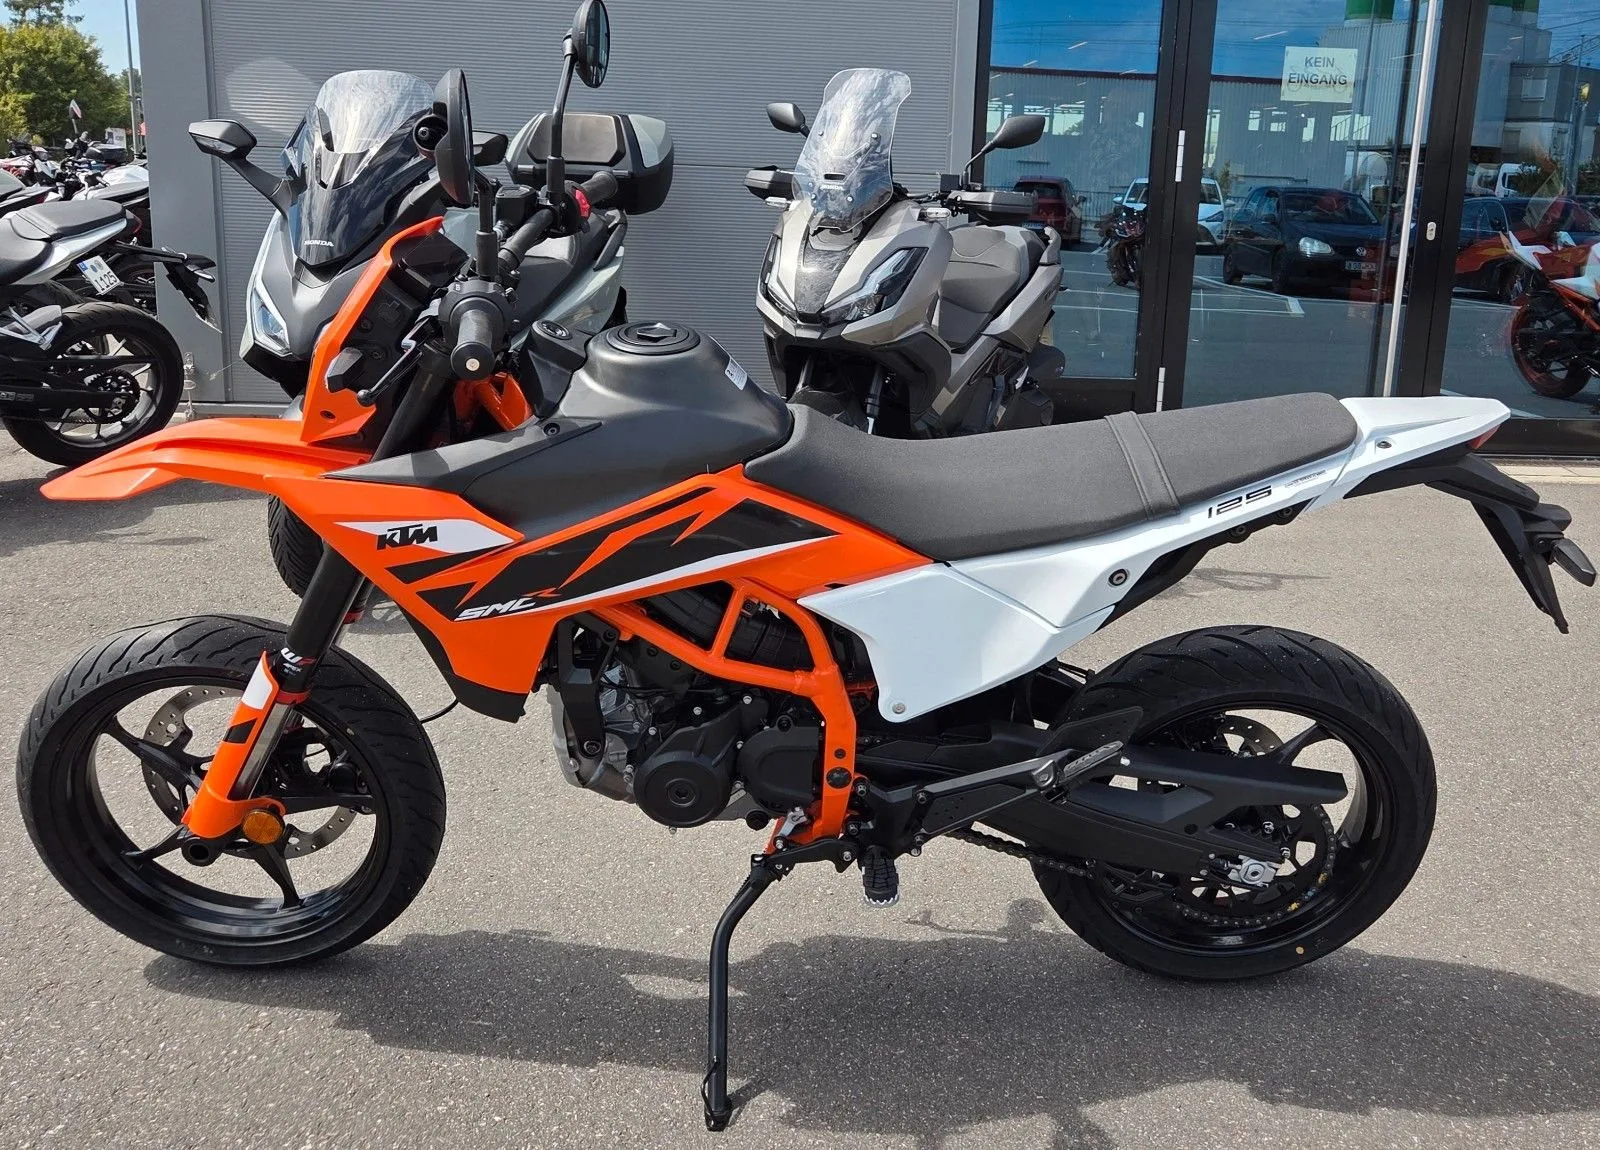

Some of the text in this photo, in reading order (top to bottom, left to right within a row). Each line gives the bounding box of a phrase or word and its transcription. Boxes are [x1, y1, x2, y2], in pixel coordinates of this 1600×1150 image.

[1304, 56, 1335, 68] KEIN
[1288, 72, 1348, 85] EINGANG
[1207, 485, 1272, 519] 125
[376, 523, 438, 550] KTM
[457, 597, 537, 619] SMC
